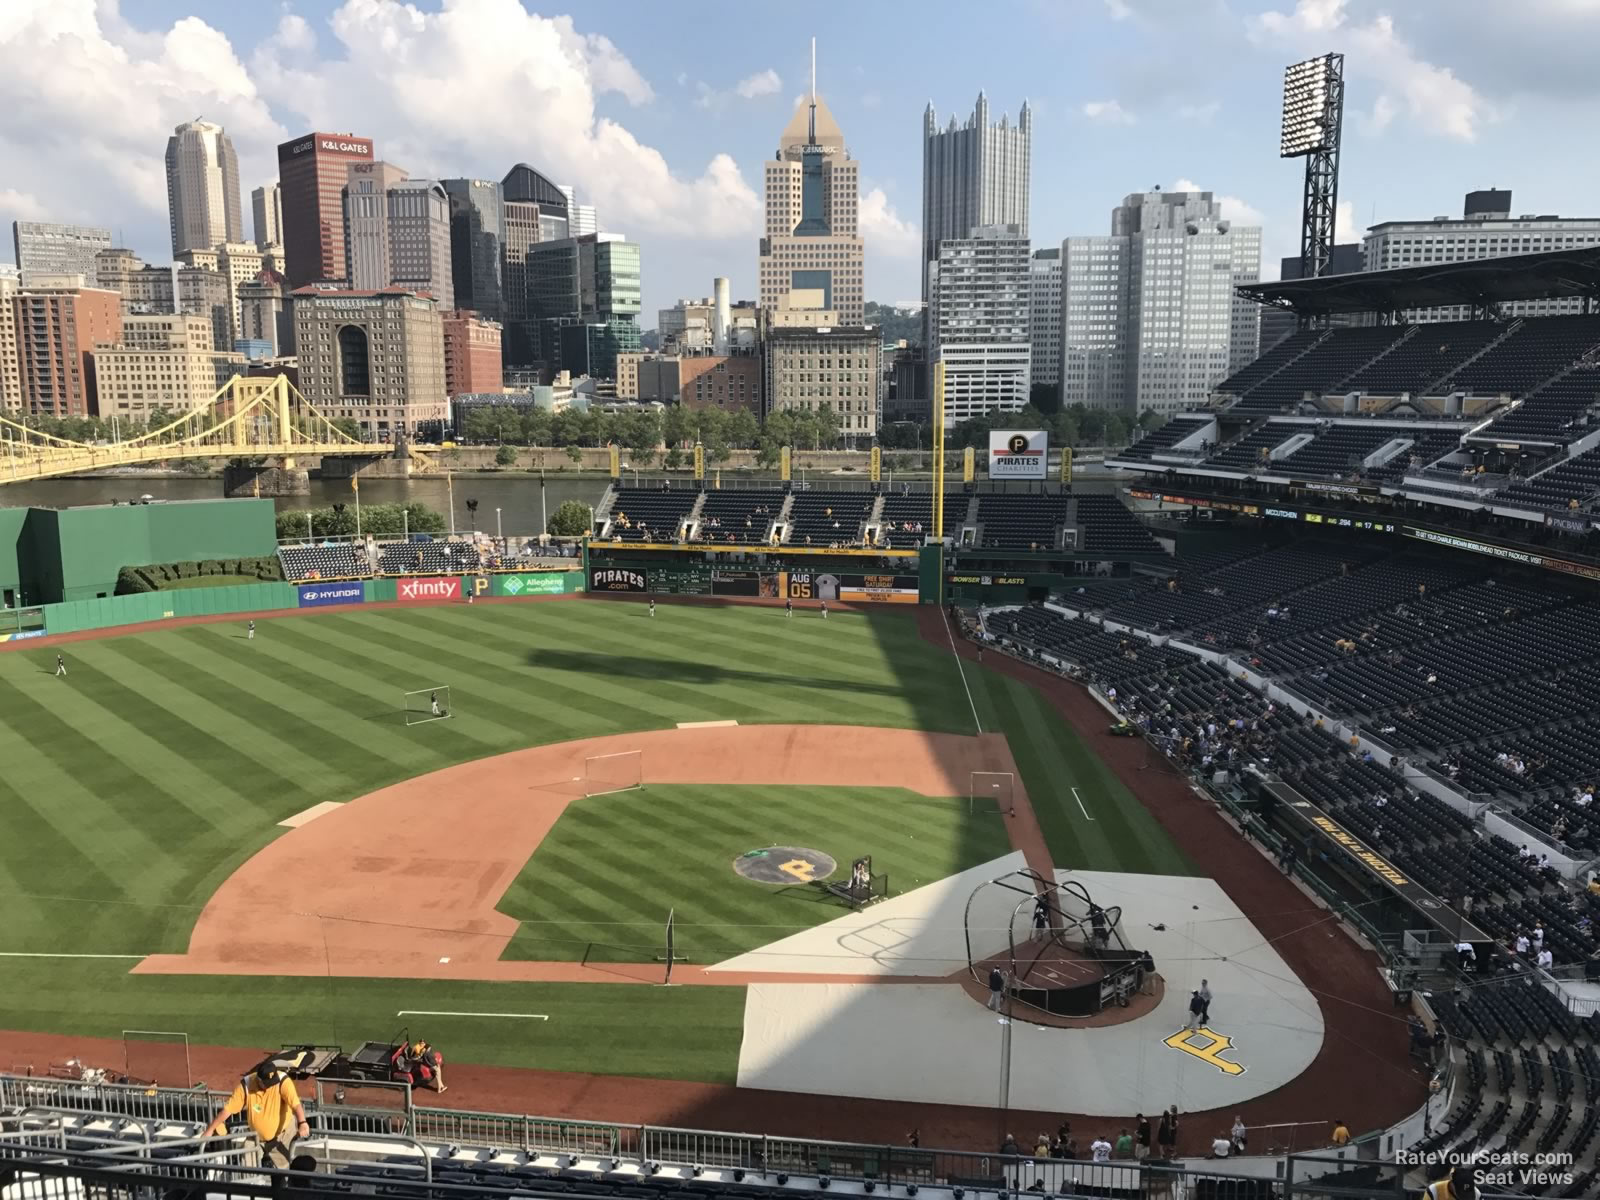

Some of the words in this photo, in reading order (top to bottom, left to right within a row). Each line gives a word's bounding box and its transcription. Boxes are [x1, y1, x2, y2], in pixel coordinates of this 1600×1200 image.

[322, 141, 339, 150] K&L
[340, 142, 368, 154] GATES
[1014, 438, 1024, 451] P
[997, 458, 1038, 466] PIRATES
[594, 570, 644, 588] PIRATES
[791, 574, 810, 583] AUG
[402, 581, 456, 598] xfinity
[475, 578, 488, 596] P
[791, 584, 811, 598] 05
[320, 590, 360, 598] HYUNDAI
[1357, 852, 1408, 885] WELCOME
